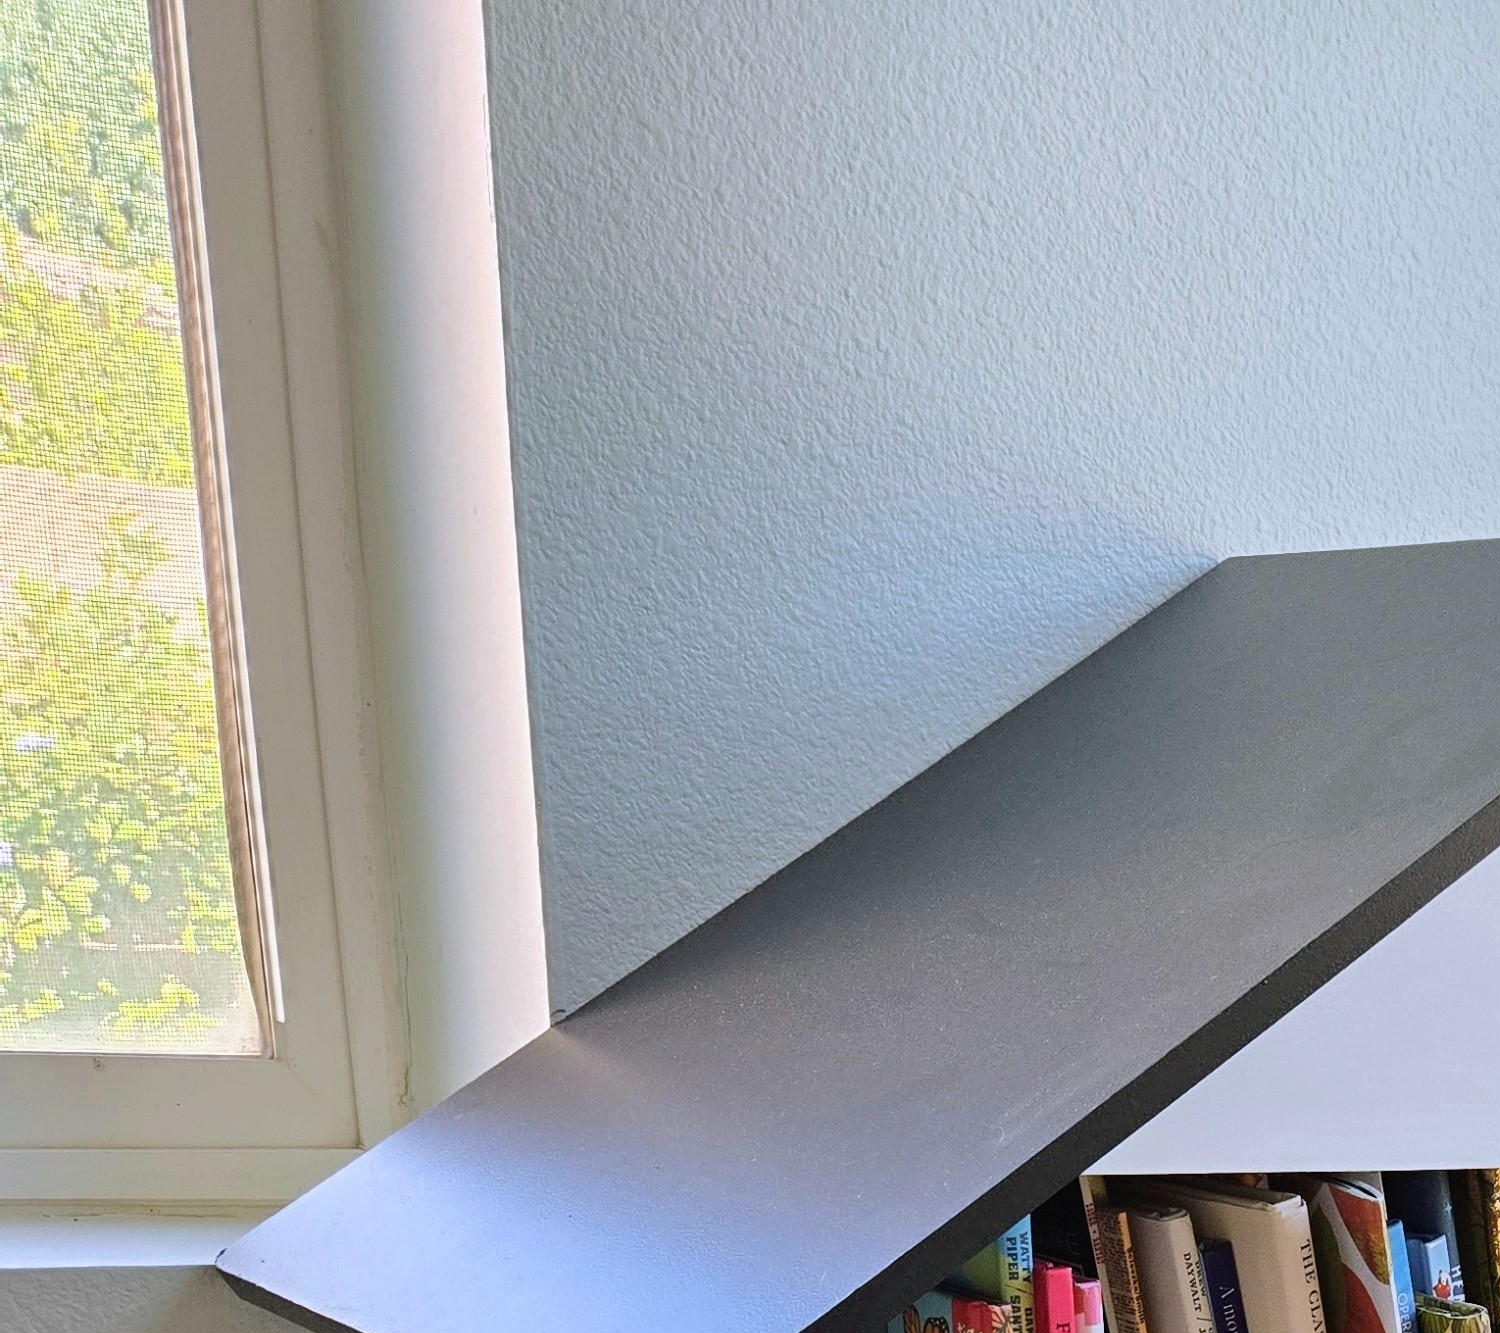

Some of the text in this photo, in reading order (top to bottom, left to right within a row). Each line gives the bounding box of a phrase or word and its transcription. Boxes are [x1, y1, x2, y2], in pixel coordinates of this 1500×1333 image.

[1006, 1236, 1020, 1281] PIPER
[1018, 1231, 1031, 1282] WATTY
[1300, 1238, 1318, 1284] THE
[1184, 1252, 1202, 1313] DAYWALT
[1219, 1285, 1236, 1299] A
